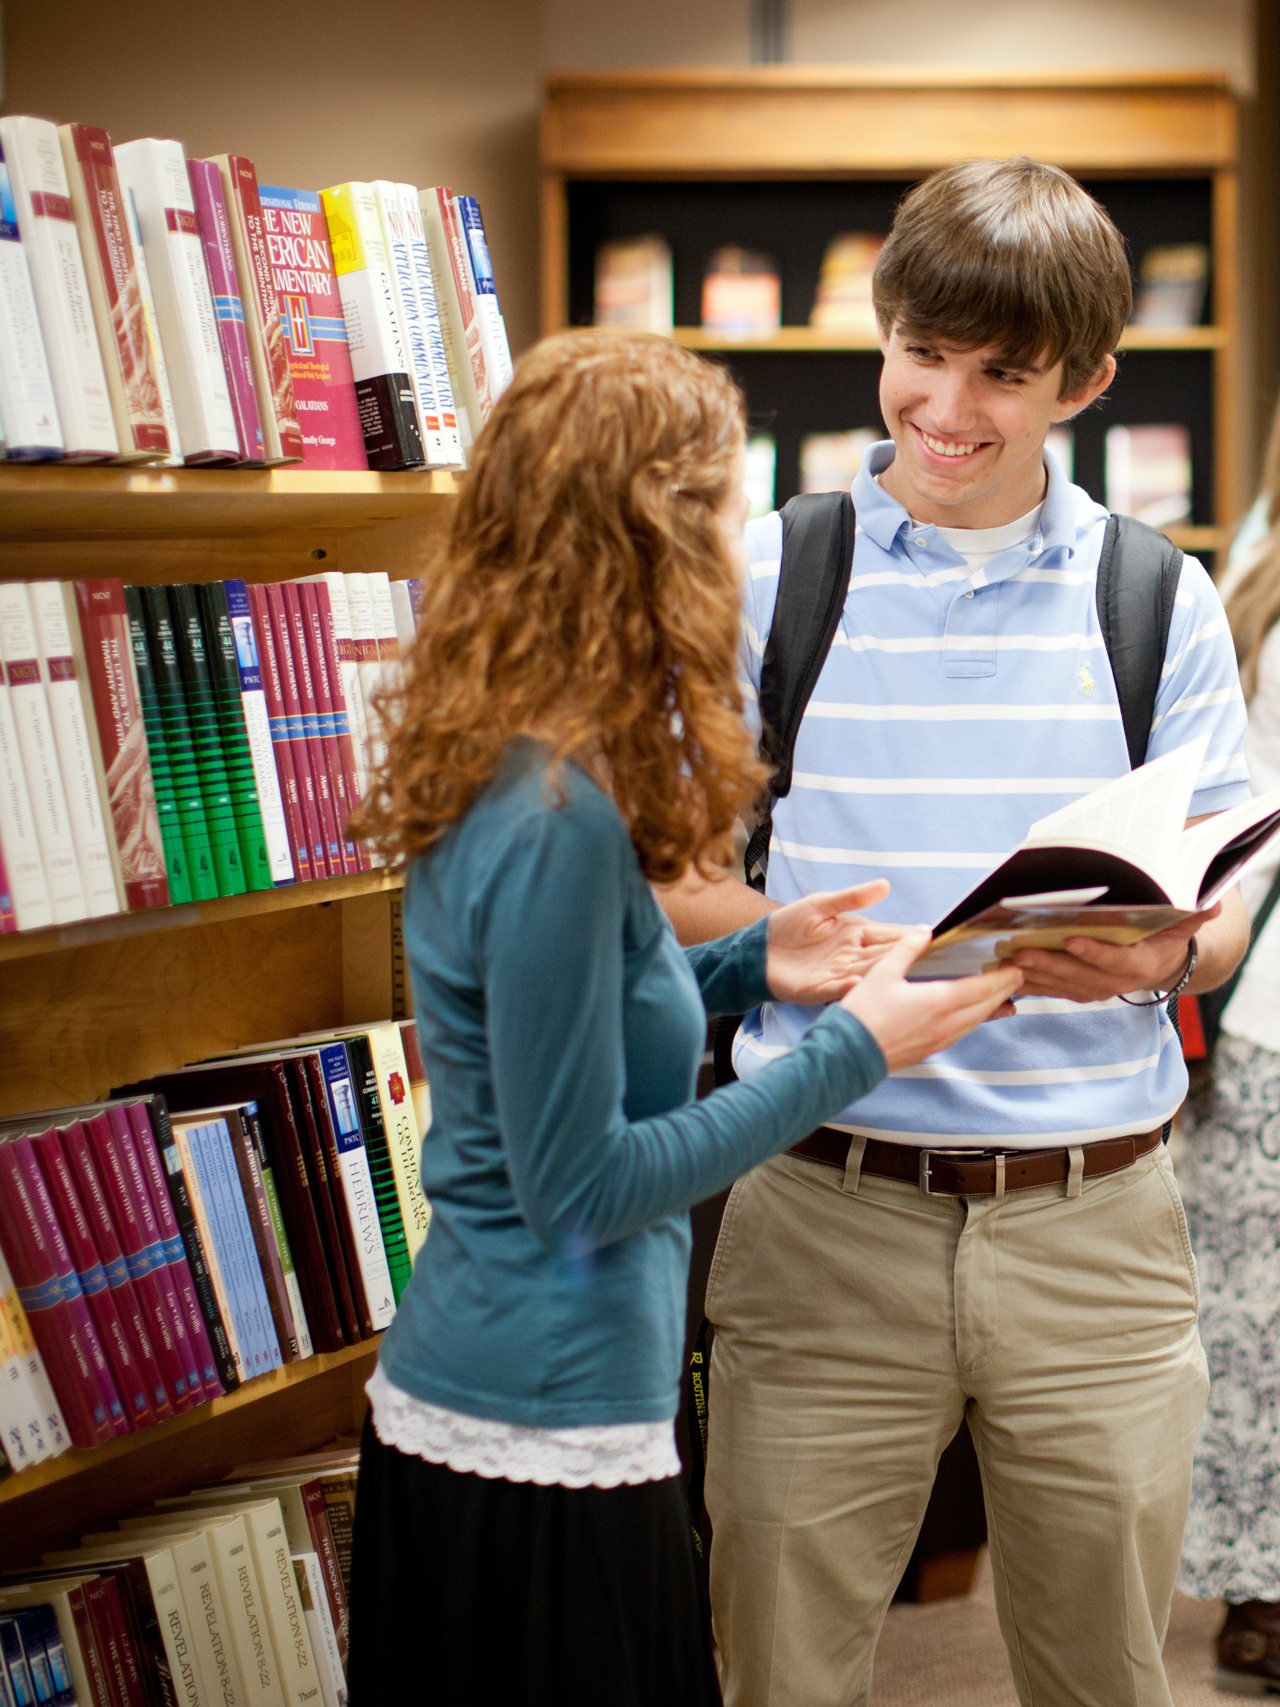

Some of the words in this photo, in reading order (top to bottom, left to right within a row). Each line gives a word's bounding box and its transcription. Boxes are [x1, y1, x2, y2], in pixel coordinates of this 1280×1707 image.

[98, 189, 108, 207] TO
[102, 208, 113, 230] THE
[106, 191, 116, 212] THE
[111, 214, 123, 244] FIRST
[292, 198, 318, 212] VERSION
[215, 209, 235, 272] CORINTHIANS
[246, 215, 254, 230] TO
[250, 233, 258, 252] THE
[254, 217, 262, 236] THE
[280, 211, 311, 236] NEW
[257, 238, 270, 282] SECOND
[265, 235, 331, 271] ERICAN
[449, 235, 469, 292] GALATIANS
[69, 263, 81, 291] First
[253, 254, 273, 326] CORINTHIANS
[73, 294, 89, 336] Epistle
[379, 271, 405, 370] GALATIANS
[391, 237, 420, 324] APPLICATION
[407, 323, 437, 415] COMMENTARY
[410, 236, 440, 322] APPLICATION
[425, 323, 454, 412] COMMENTARY
[295, 400, 329, 412] GALATIANS
[318, 434, 337, 447] George
[108, 638, 119, 658] THE
[265, 631, 282, 701] THESSALONIANS
[282, 630, 298, 699] THESSALONIANS
[297, 628, 313, 698] THESSALONIANS
[315, 628, 330, 697] THESSALONIANS
[99, 639, 117, 691] TIMOTHY
[108, 691, 122, 719] AND
[112, 662, 129, 708] LETTERS
[244, 675, 260, 684] PNTC
[121, 710, 131, 727] TO
[246, 700, 254, 720] AND
[250, 723, 257, 735] TO
[252, 737, 269, 797] PHILEMON
[259, 732, 276, 801] COLOSSIANS
[305, 776, 314, 801] Martin
[319, 774, 329, 798] Martin
[336, 773, 345, 797] Martin
[351, 771, 360, 795] Martin
[288, 778, 298, 803] Martin
[252, 1119, 267, 1163] Exposition
[344, 1133, 359, 1145] PNTC
[125, 1151, 144, 1194] TIMOTHY
[140, 1203, 155, 1231] TITUS
[144, 1146, 162, 1188] TIMOTHY
[158, 1197, 172, 1225] TITUS
[244, 1147, 261, 1188] TIMOTHY
[256, 1196, 270, 1227] STOTT
[394, 1122, 405, 1145] ON
[400, 1151, 423, 1230] HEBREWS
[400, 1115, 429, 1229] COMMENTARY
[34, 1181, 55, 1224] TIMOTHY
[52, 1233, 68, 1262] TITUS
[348, 1162, 376, 1255] HEBREWS
[270, 1198, 283, 1233] TIMOTHY
[280, 1241, 290, 1265] TITUS
[165, 1291, 176, 1308] Lea
[172, 1314, 185, 1339] Griffin
[183, 1285, 194, 1303] Lea
[189, 1308, 202, 1333] Griffin
[83, 1321, 94, 1338] Lea
[90, 1343, 105, 1369] Griffin
[288, 1338, 298, 1353] IVP
[691, 1370, 707, 1416] ROUTINE
[310, 1563, 318, 1580] The
[321, 1536, 331, 1556] THE
[326, 1559, 338, 1589] BOOK
[334, 1591, 342, 1606] OF
[273, 1547, 301, 1638] REVELATION
[293, 1638, 309, 1668] 8-22
[313, 1580, 327, 1624] Revelation
[199, 1582, 229, 1676] REVELATION
[219, 1676, 236, 1707] 8-22
[236, 1565, 265, 1658] REVELATION
[256, 1658, 271, 1688] 8-22
[323, 1626, 330, 1636] of
[325, 1636, 335, 1659] John
[88, 1649, 98, 1669] THE
[107, 1639, 120, 1661] THE
[166, 1610, 201, 1707] REVELATION
[298, 1687, 319, 1702] Thomas
